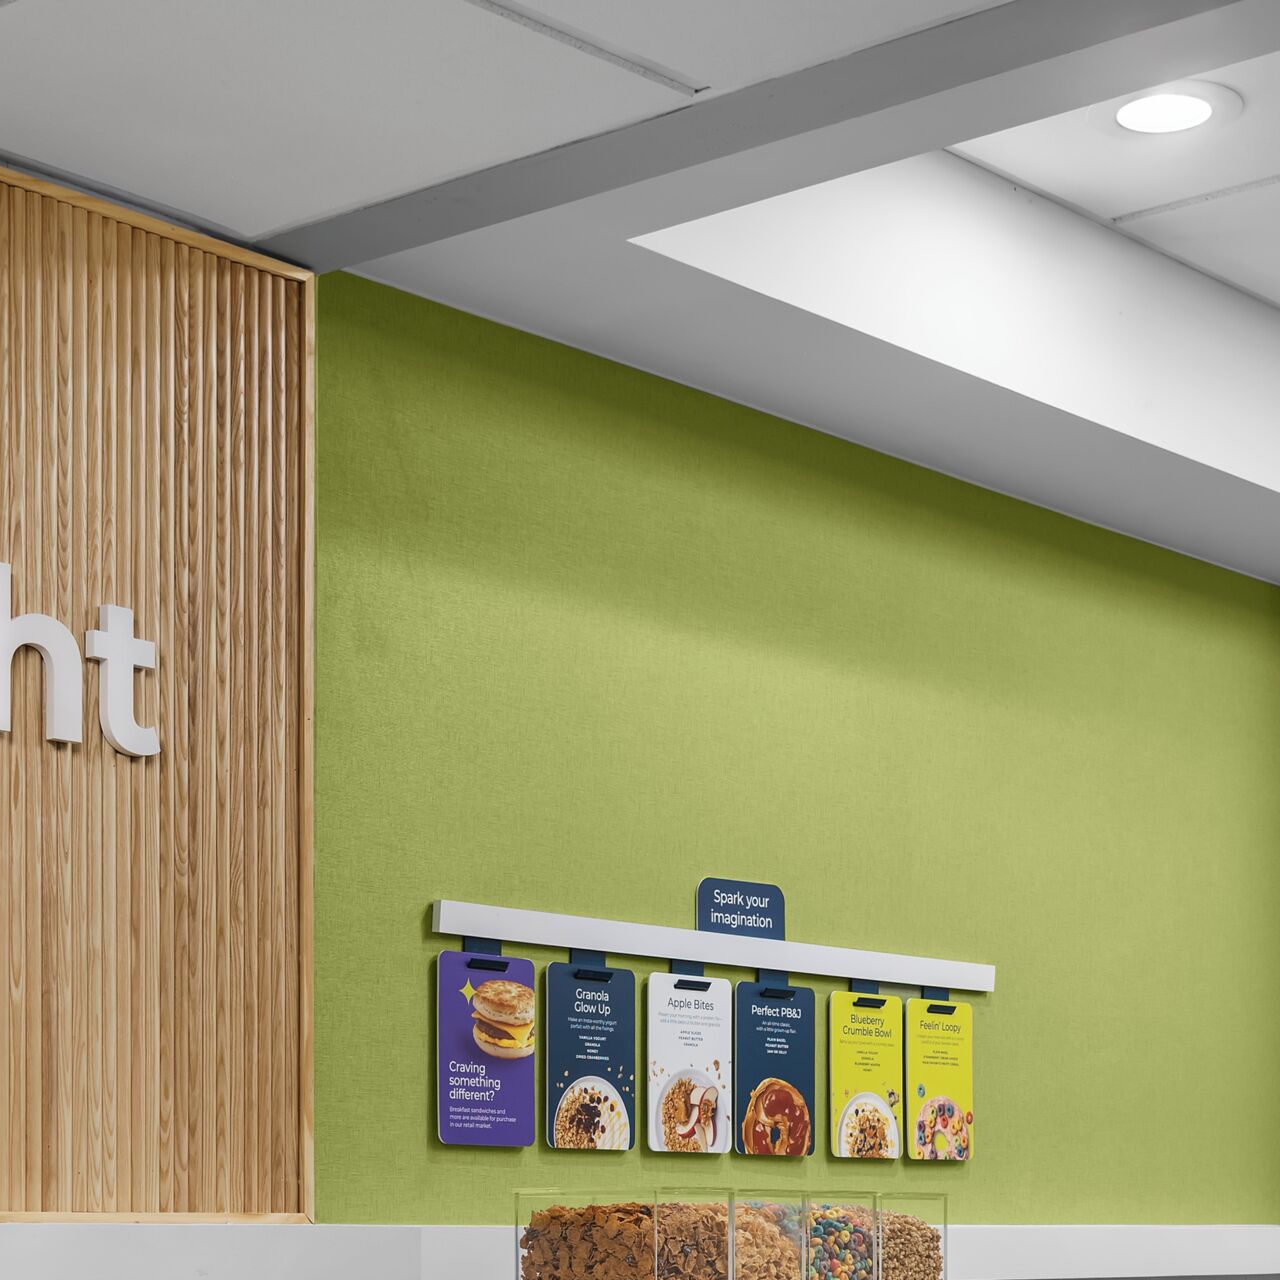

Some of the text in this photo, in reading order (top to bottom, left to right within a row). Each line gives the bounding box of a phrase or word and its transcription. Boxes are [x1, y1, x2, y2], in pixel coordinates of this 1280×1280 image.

[714, 890, 769, 909] Spark your
[711, 908, 772, 928] imagination
[576, 988, 609, 1001] Granola
[574, 1001, 610, 1016] Glow Up
[668, 997, 714, 1010] Apple Bites
[752, 1005, 801, 1018] Perfect PB&J
[851, 1014, 884, 1028] Blueberry
[843, 1025, 891, 1038] Crumble Bowl
[942, 1022, 961, 1034] Loopy
[449, 1061, 485, 1076] Craving
[449, 1076, 500, 1090] something
[449, 1088, 494, 1101] different?
